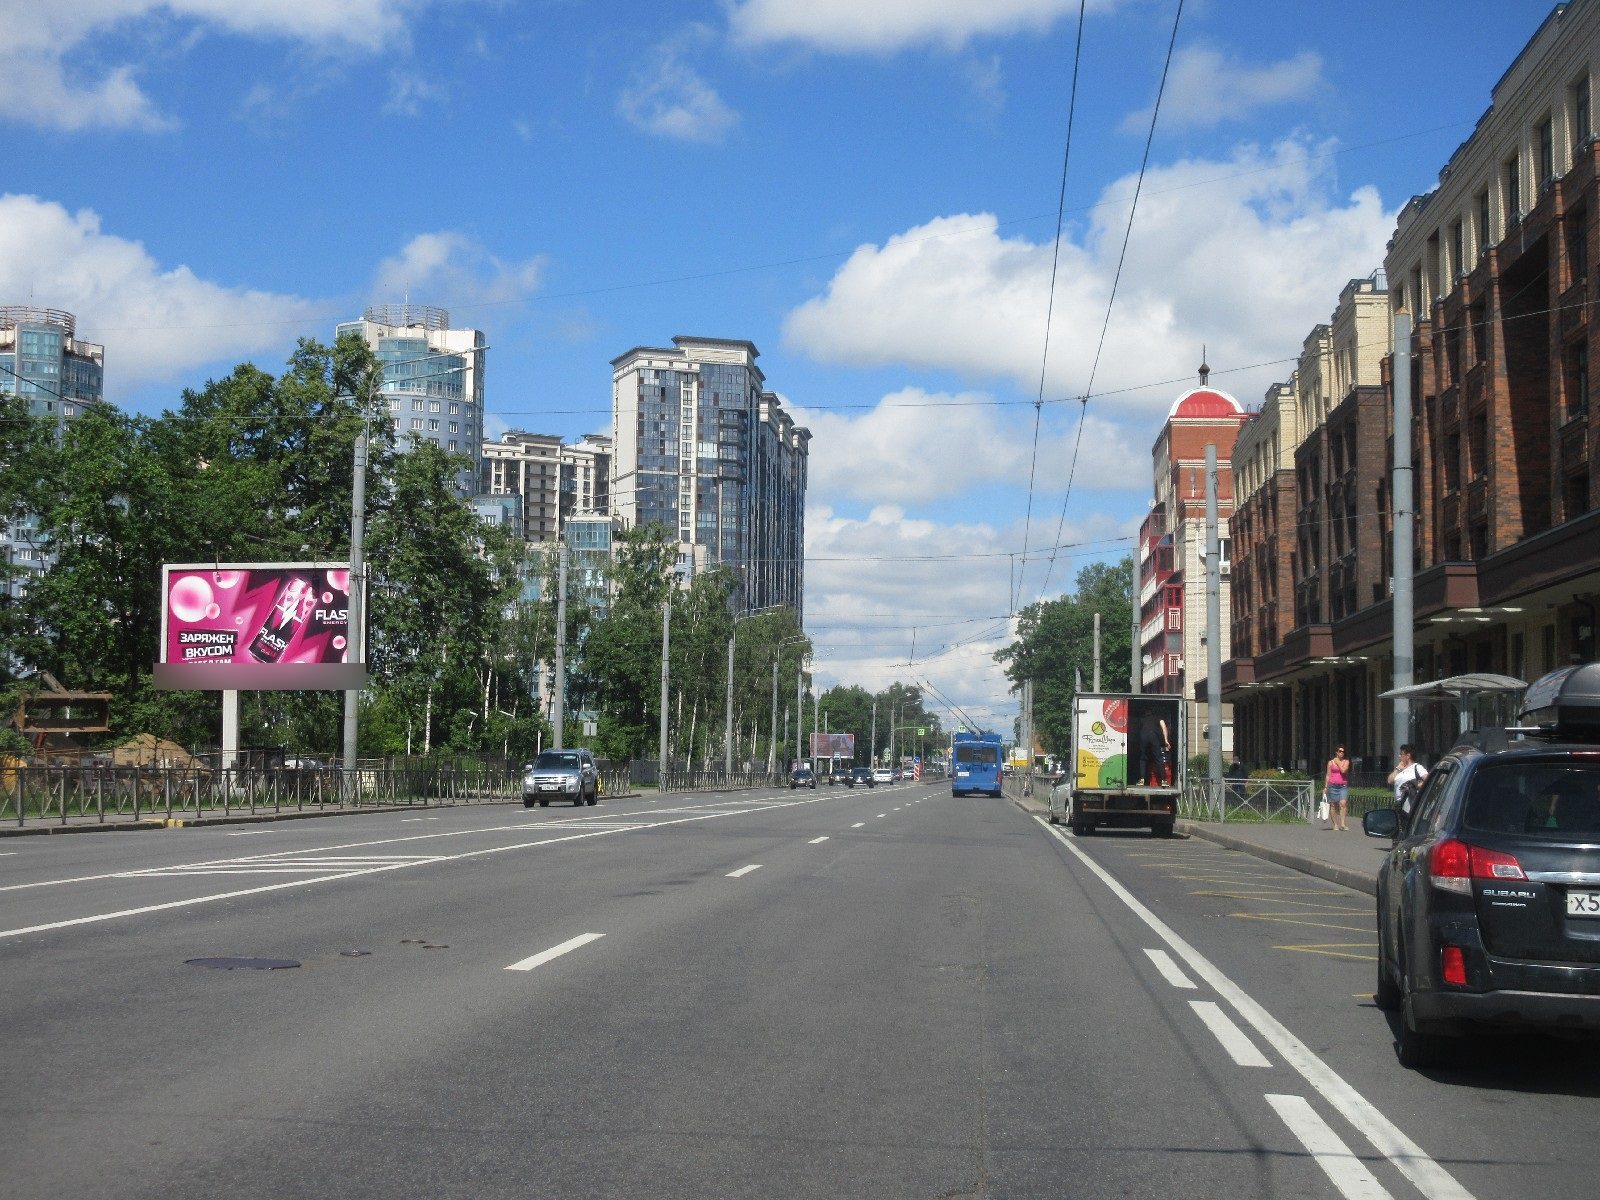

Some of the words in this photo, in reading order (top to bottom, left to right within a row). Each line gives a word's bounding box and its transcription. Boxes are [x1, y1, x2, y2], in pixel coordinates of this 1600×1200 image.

[315, 609, 348, 621] FLAS
[180, 633, 234, 644] ЗАРЯЖЕН
[185, 645, 233, 658] ВКУСОМ
[1482, 889, 1536, 899] SUBARU
